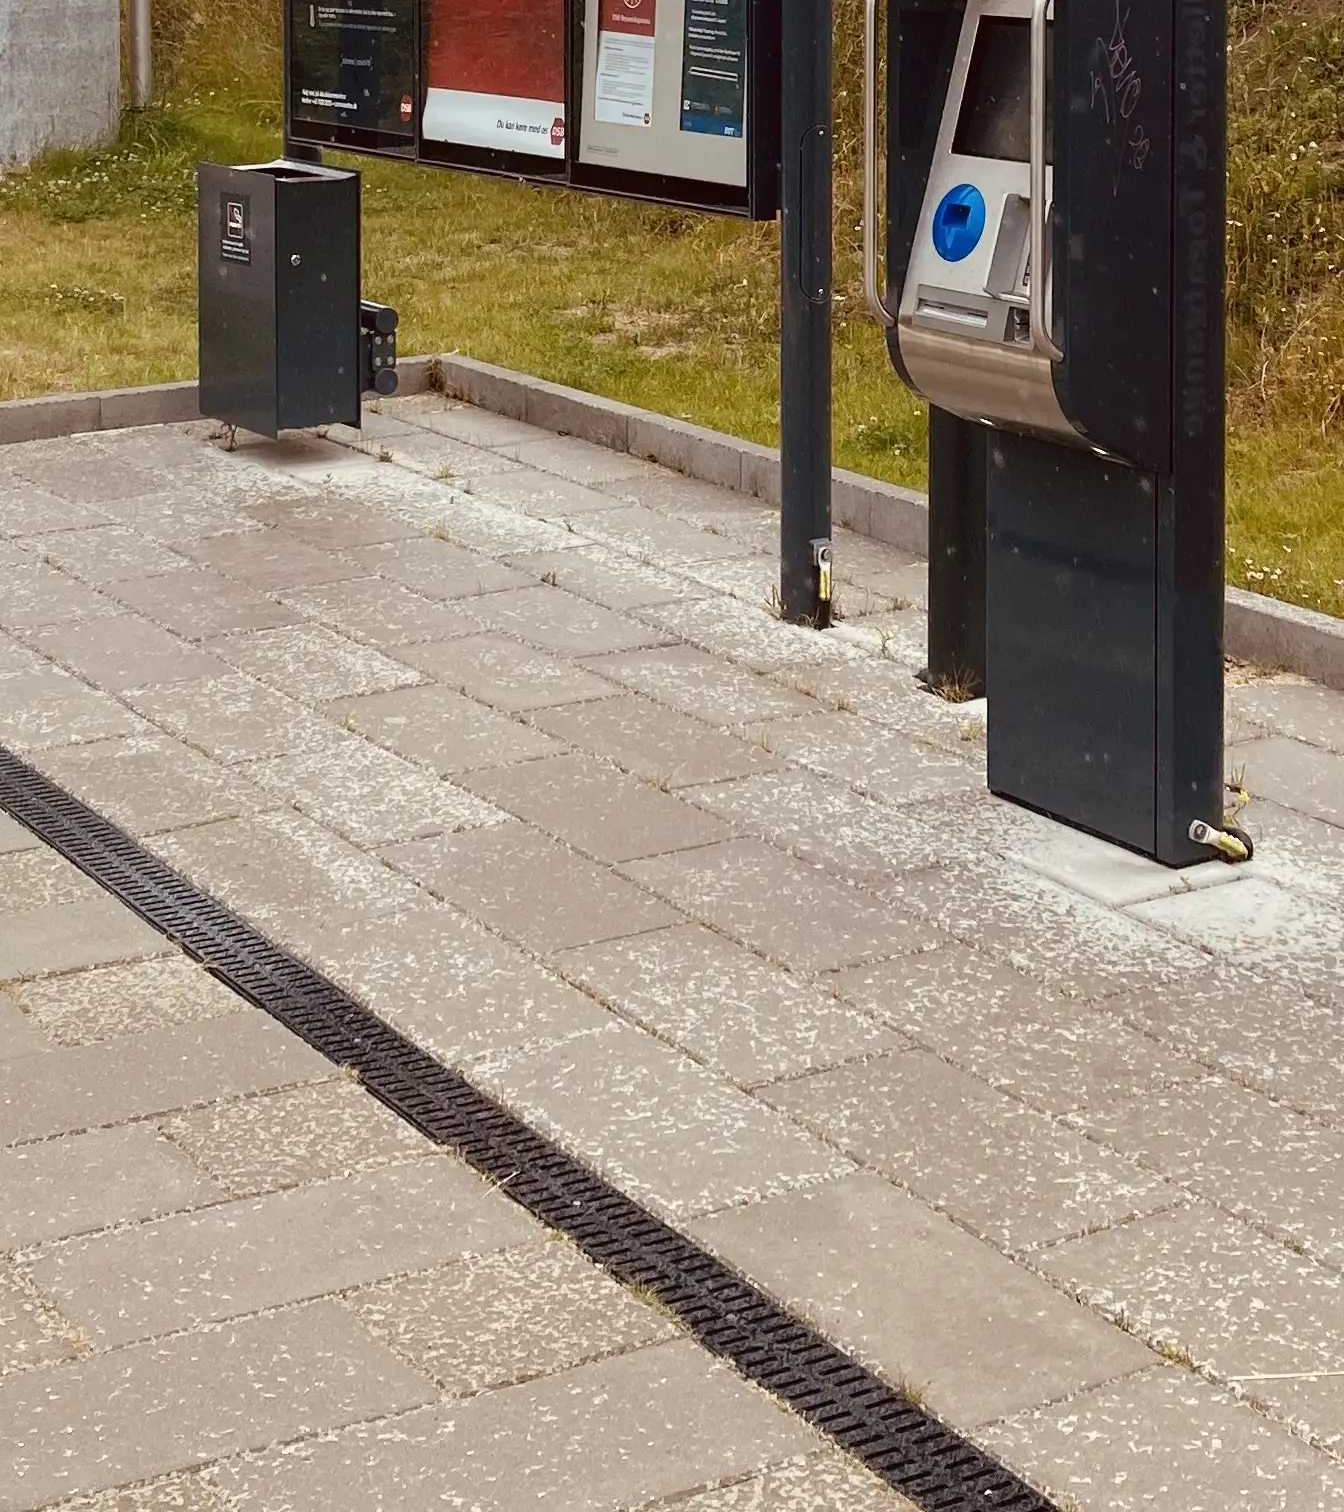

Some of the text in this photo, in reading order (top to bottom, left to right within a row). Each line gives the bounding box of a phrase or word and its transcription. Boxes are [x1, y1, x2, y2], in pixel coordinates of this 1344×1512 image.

[496, 119, 504, 129] Du
[505, 120, 515, 130] kan
[528, 124, 541, 134] med
[541, 127, 548, 135] os
[551, 126, 564, 137] DSB
